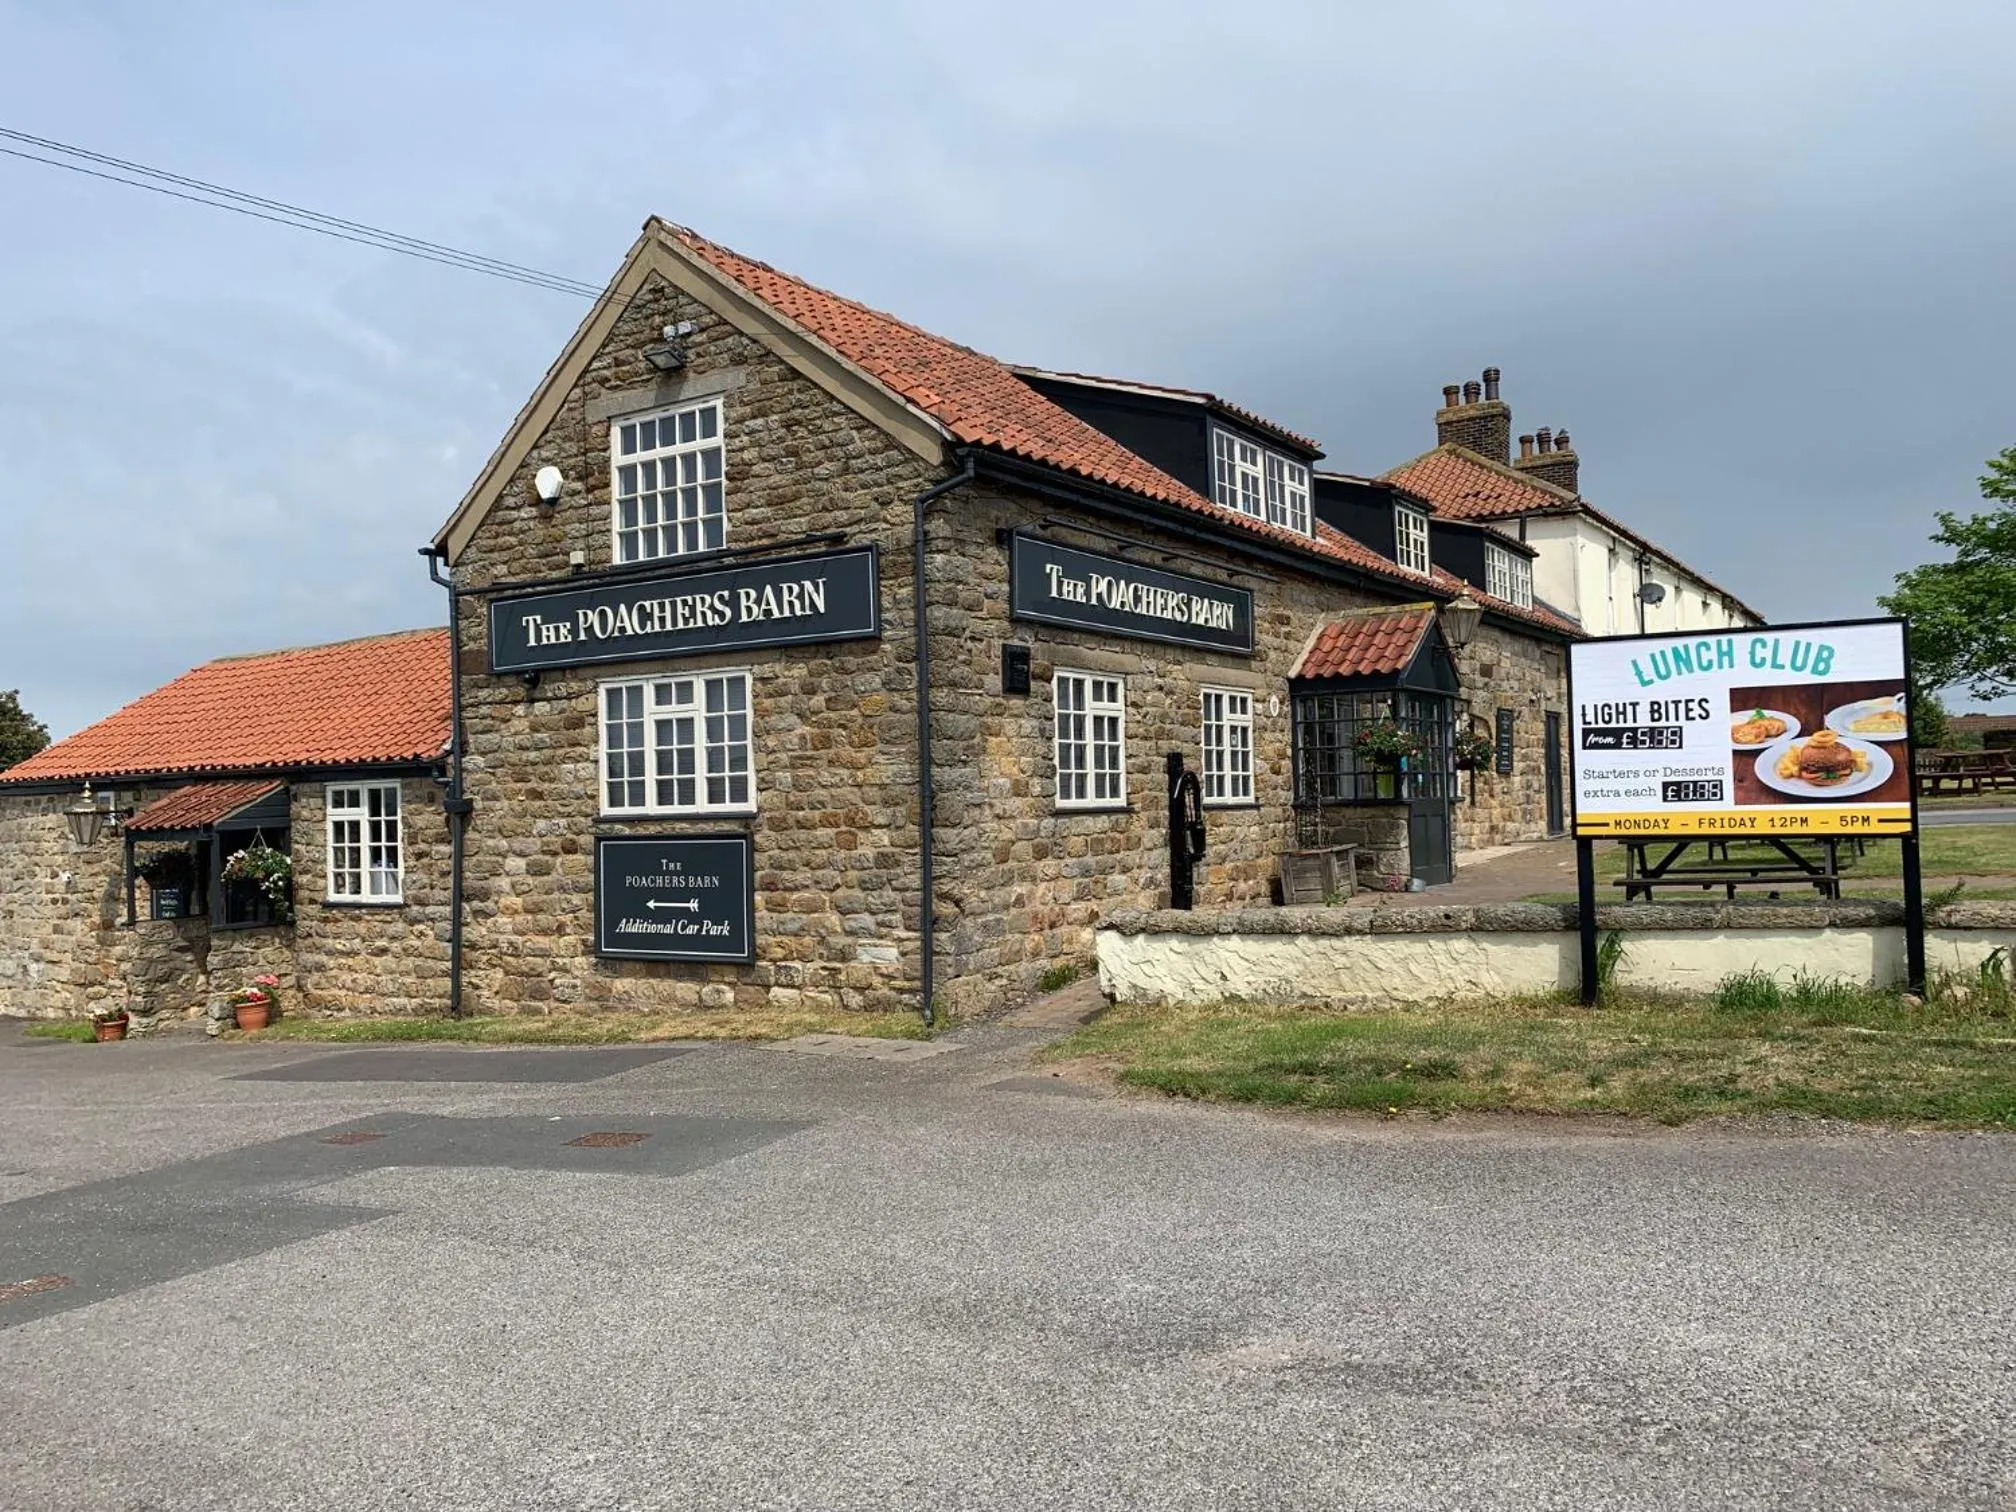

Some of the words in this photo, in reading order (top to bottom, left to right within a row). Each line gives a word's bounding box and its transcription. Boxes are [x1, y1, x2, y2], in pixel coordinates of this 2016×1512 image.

[575, 589, 732, 641] POACHERS
[737, 578, 827, 624] BARN
[1088, 573, 1189, 623] POACHERS
[1189, 593, 1235, 632] BARN
[1631, 638, 1735, 688] LUNCH
[1749, 636, 1836, 677] CLUB
[1581, 701, 1640, 726] LIGHT
[1649, 697, 1711, 722] BITES
[1586, 733, 1616, 747] from
[1582, 768, 1641, 780] Starters
[1643, 770, 1659, 778] or
[1663, 766, 1725, 778] Desserts
[1583, 788, 1621, 798] extra
[1624, 786, 1657, 797] each
[1614, 818, 1670, 830] MONDAY
[1698, 817, 1757, 828] FRIDAY
[1768, 816, 1809, 828] 12PM
[1839, 815, 1871, 827] 5PM
[625, 875, 685, 888] POACHERS
[688, 875, 719, 888] BARN
[615, 918, 675, 935] Additional
[677, 919, 699, 935] Car
[701, 919, 730, 936] Park
